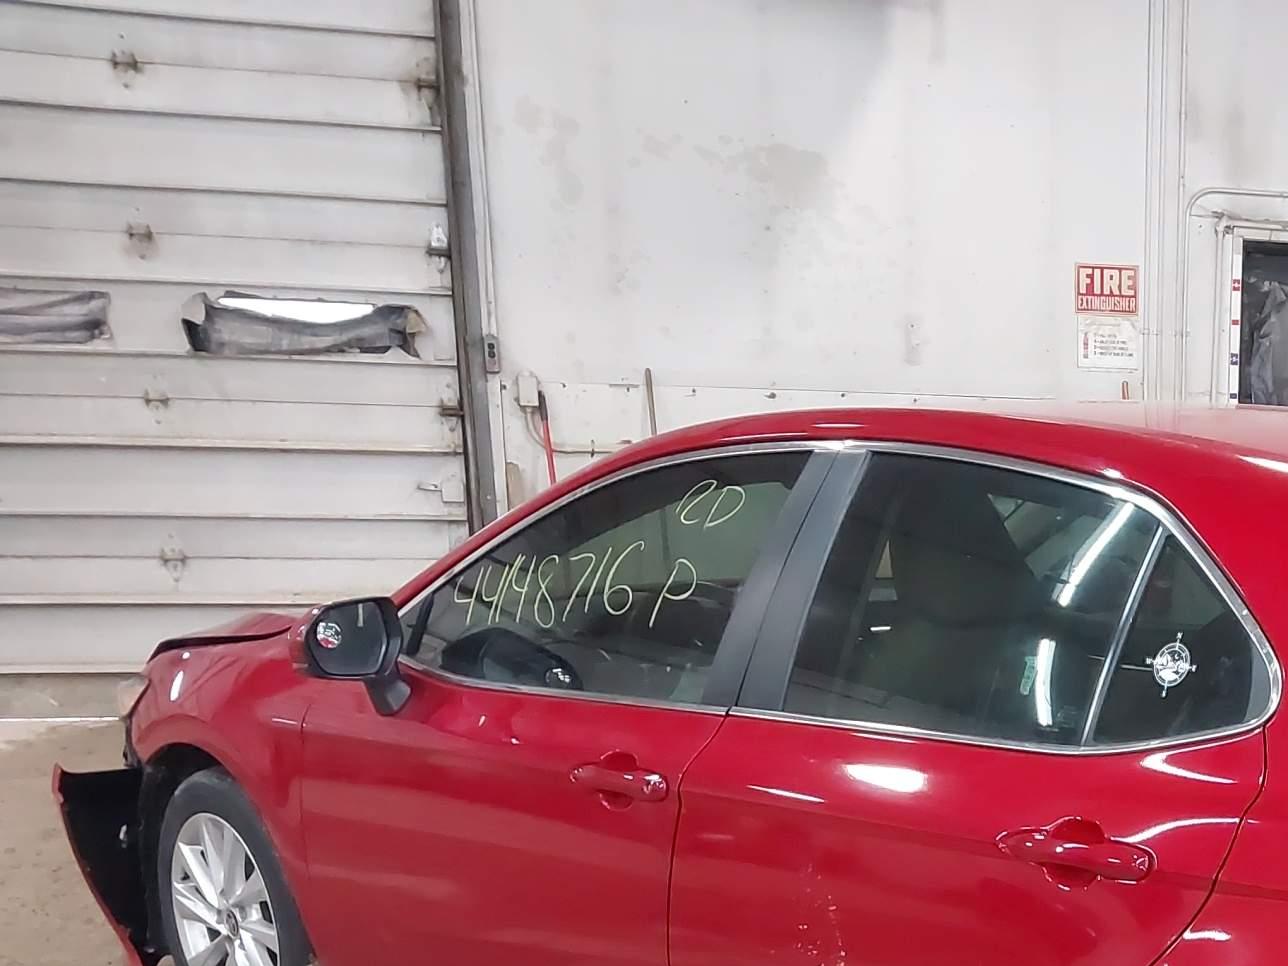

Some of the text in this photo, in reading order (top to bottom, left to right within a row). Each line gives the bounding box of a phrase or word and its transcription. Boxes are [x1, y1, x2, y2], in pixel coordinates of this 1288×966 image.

[1078, 267, 1136, 296] FIRE
[1078, 295, 1136, 312] EXTINGUISHER
[453, 540, 697, 629] 44148716 P
